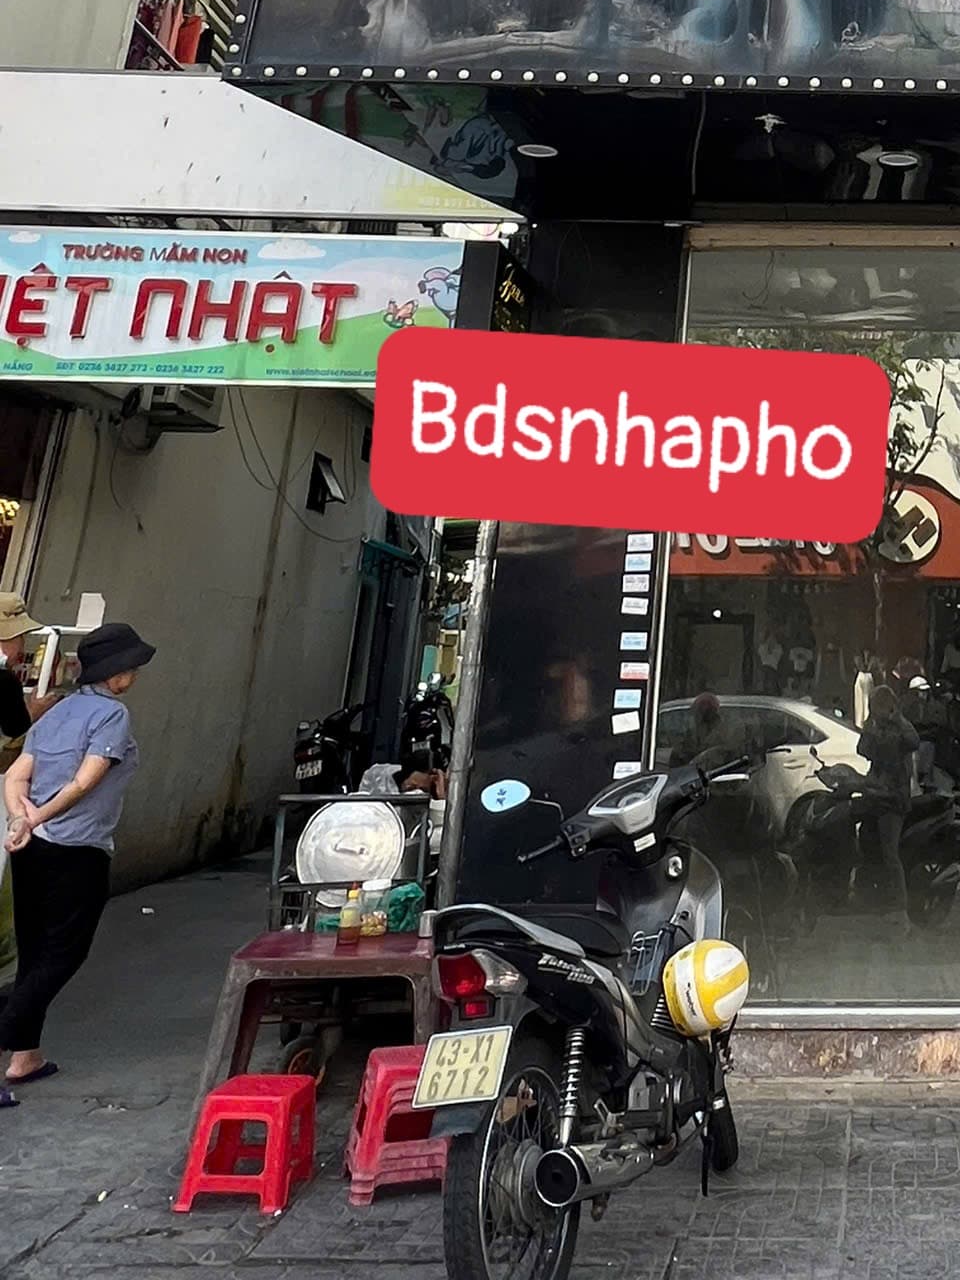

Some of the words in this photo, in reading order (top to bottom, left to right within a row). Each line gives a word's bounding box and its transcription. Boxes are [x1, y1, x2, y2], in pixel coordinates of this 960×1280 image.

[202, 247, 248, 264] NON
[0, 262, 114, 347] ỆT
[128, 270, 358, 354] NHẬT
[435, 1033, 495, 1068] 43-X1
[426, 1065, 490, 1101] 6712
